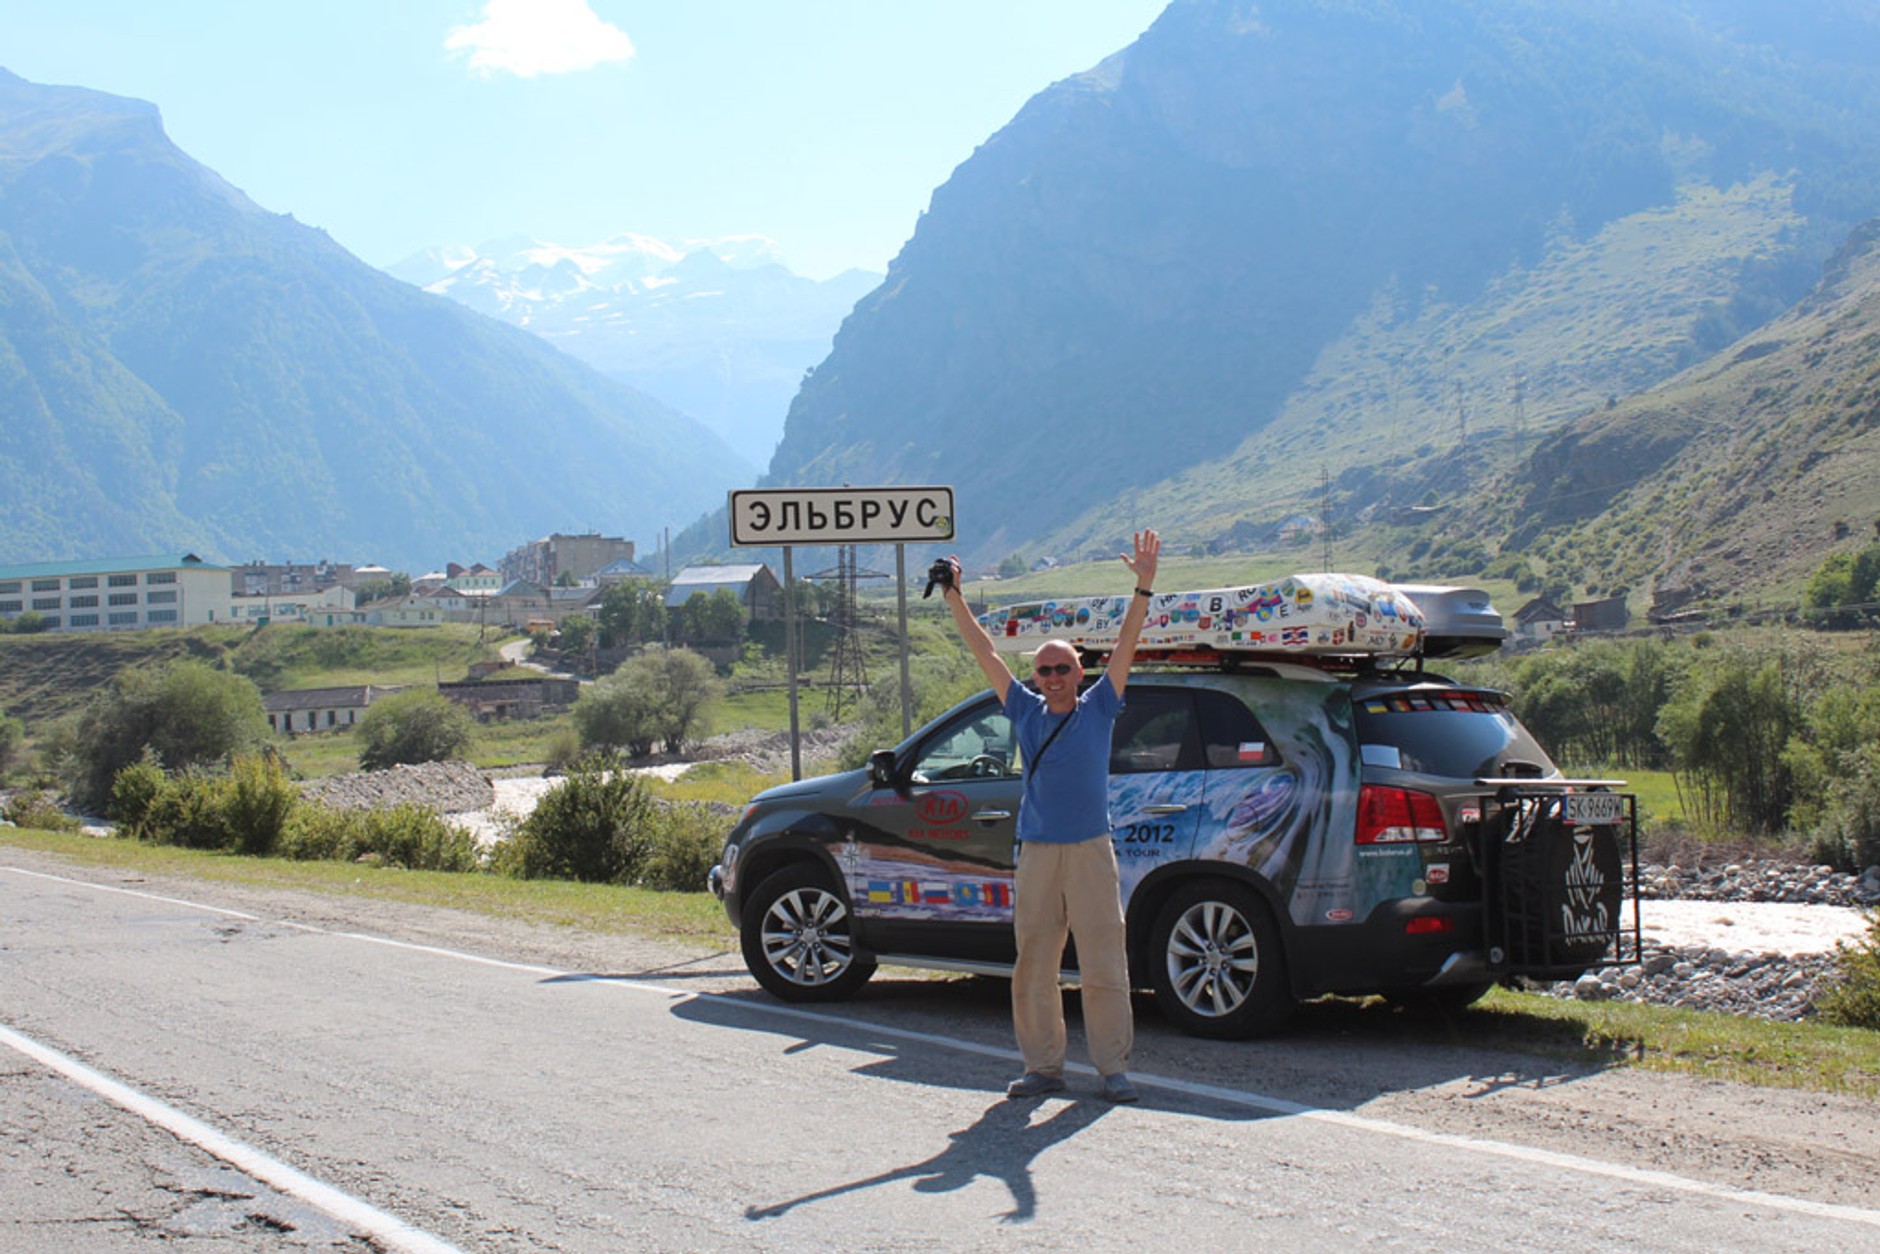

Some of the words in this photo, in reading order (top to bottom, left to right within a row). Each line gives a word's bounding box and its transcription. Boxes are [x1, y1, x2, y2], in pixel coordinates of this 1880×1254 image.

[749, 498, 937, 531] ЭЛЬБРУС
[1210, 597, 1223, 612] B
[924, 798, 959, 816] KIA
[1125, 825, 1175, 843] 2012
